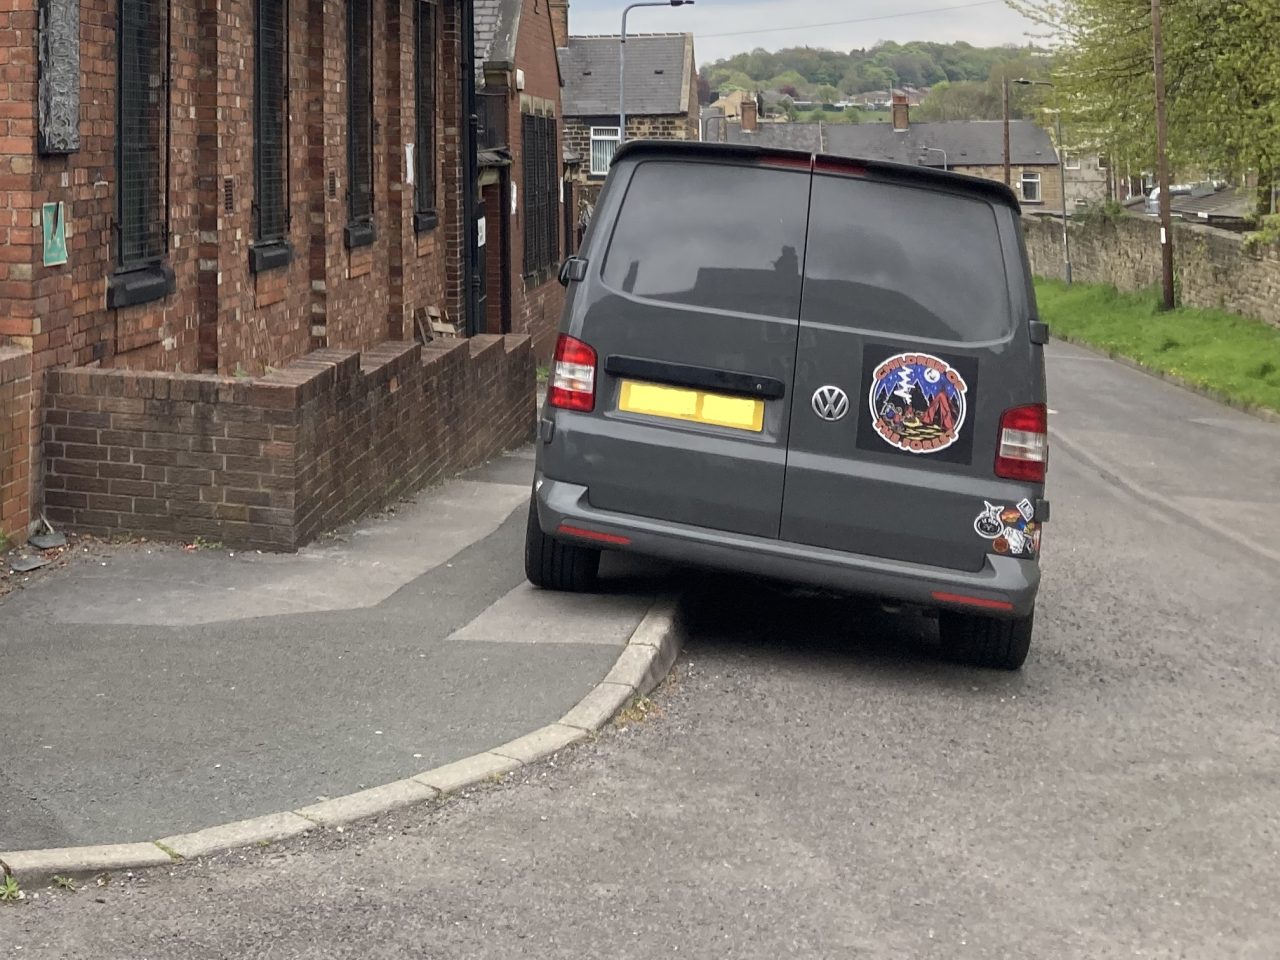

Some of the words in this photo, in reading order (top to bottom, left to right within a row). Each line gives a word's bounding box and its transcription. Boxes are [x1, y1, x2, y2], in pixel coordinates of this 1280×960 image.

[876, 355, 947, 380] CHILDREN
[946, 370, 964, 391] OF
[876, 418, 900, 444] THE
[902, 429, 956, 450] FOREST
